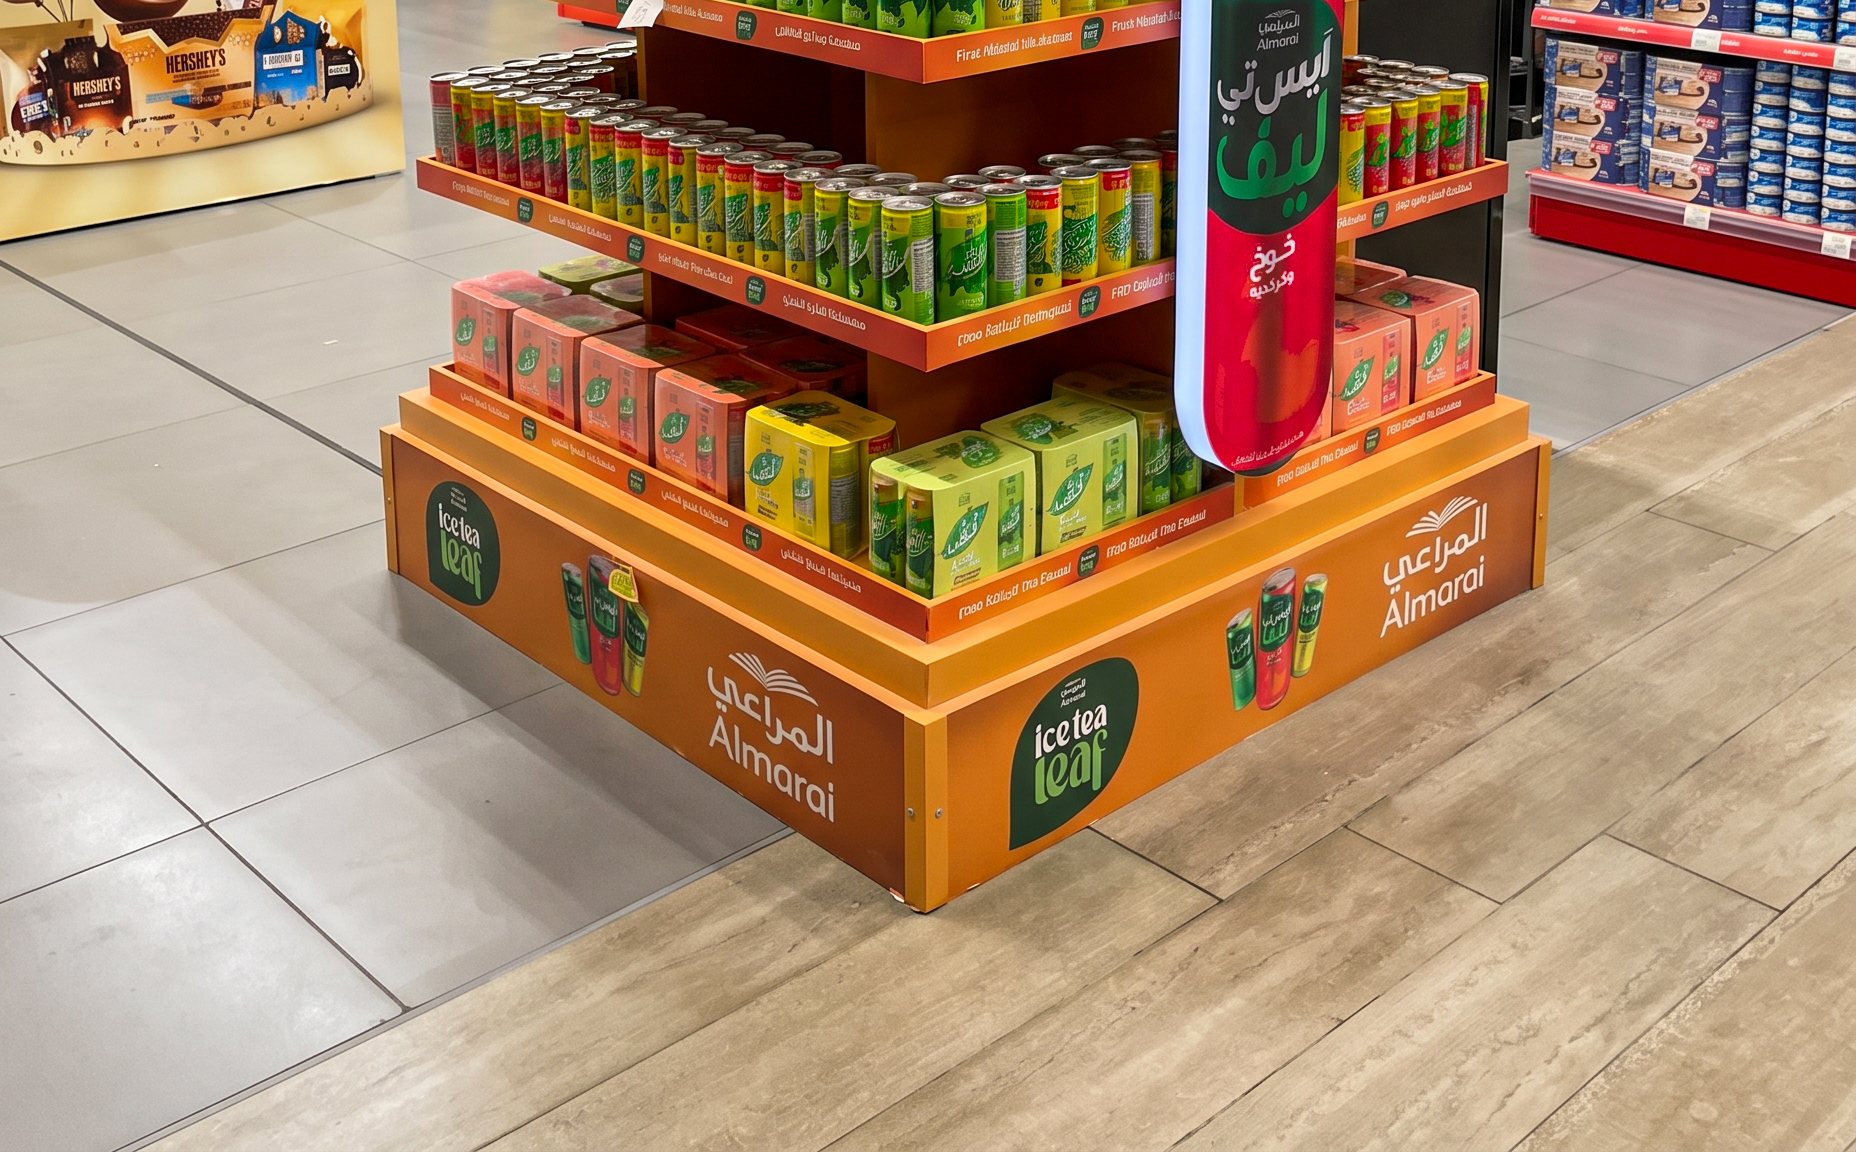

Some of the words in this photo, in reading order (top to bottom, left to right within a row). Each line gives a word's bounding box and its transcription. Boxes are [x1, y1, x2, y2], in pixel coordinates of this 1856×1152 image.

[73, 76, 122, 97] HERSHEY'S
[166, 48, 226, 75] HERSHEY'S
[438, 502, 460, 537] ice
[459, 516, 480, 549] tea
[1382, 503, 1488, 594] المراعي
[440, 528, 482, 601] leaf
[1380, 554, 1486, 639] Almarai
[707, 665, 834, 765] المراعي
[1035, 723, 1071, 759] ice
[1072, 703, 1108, 740] tea
[708, 715, 835, 823] Almarai
[1034, 728, 1108, 805] leaf
